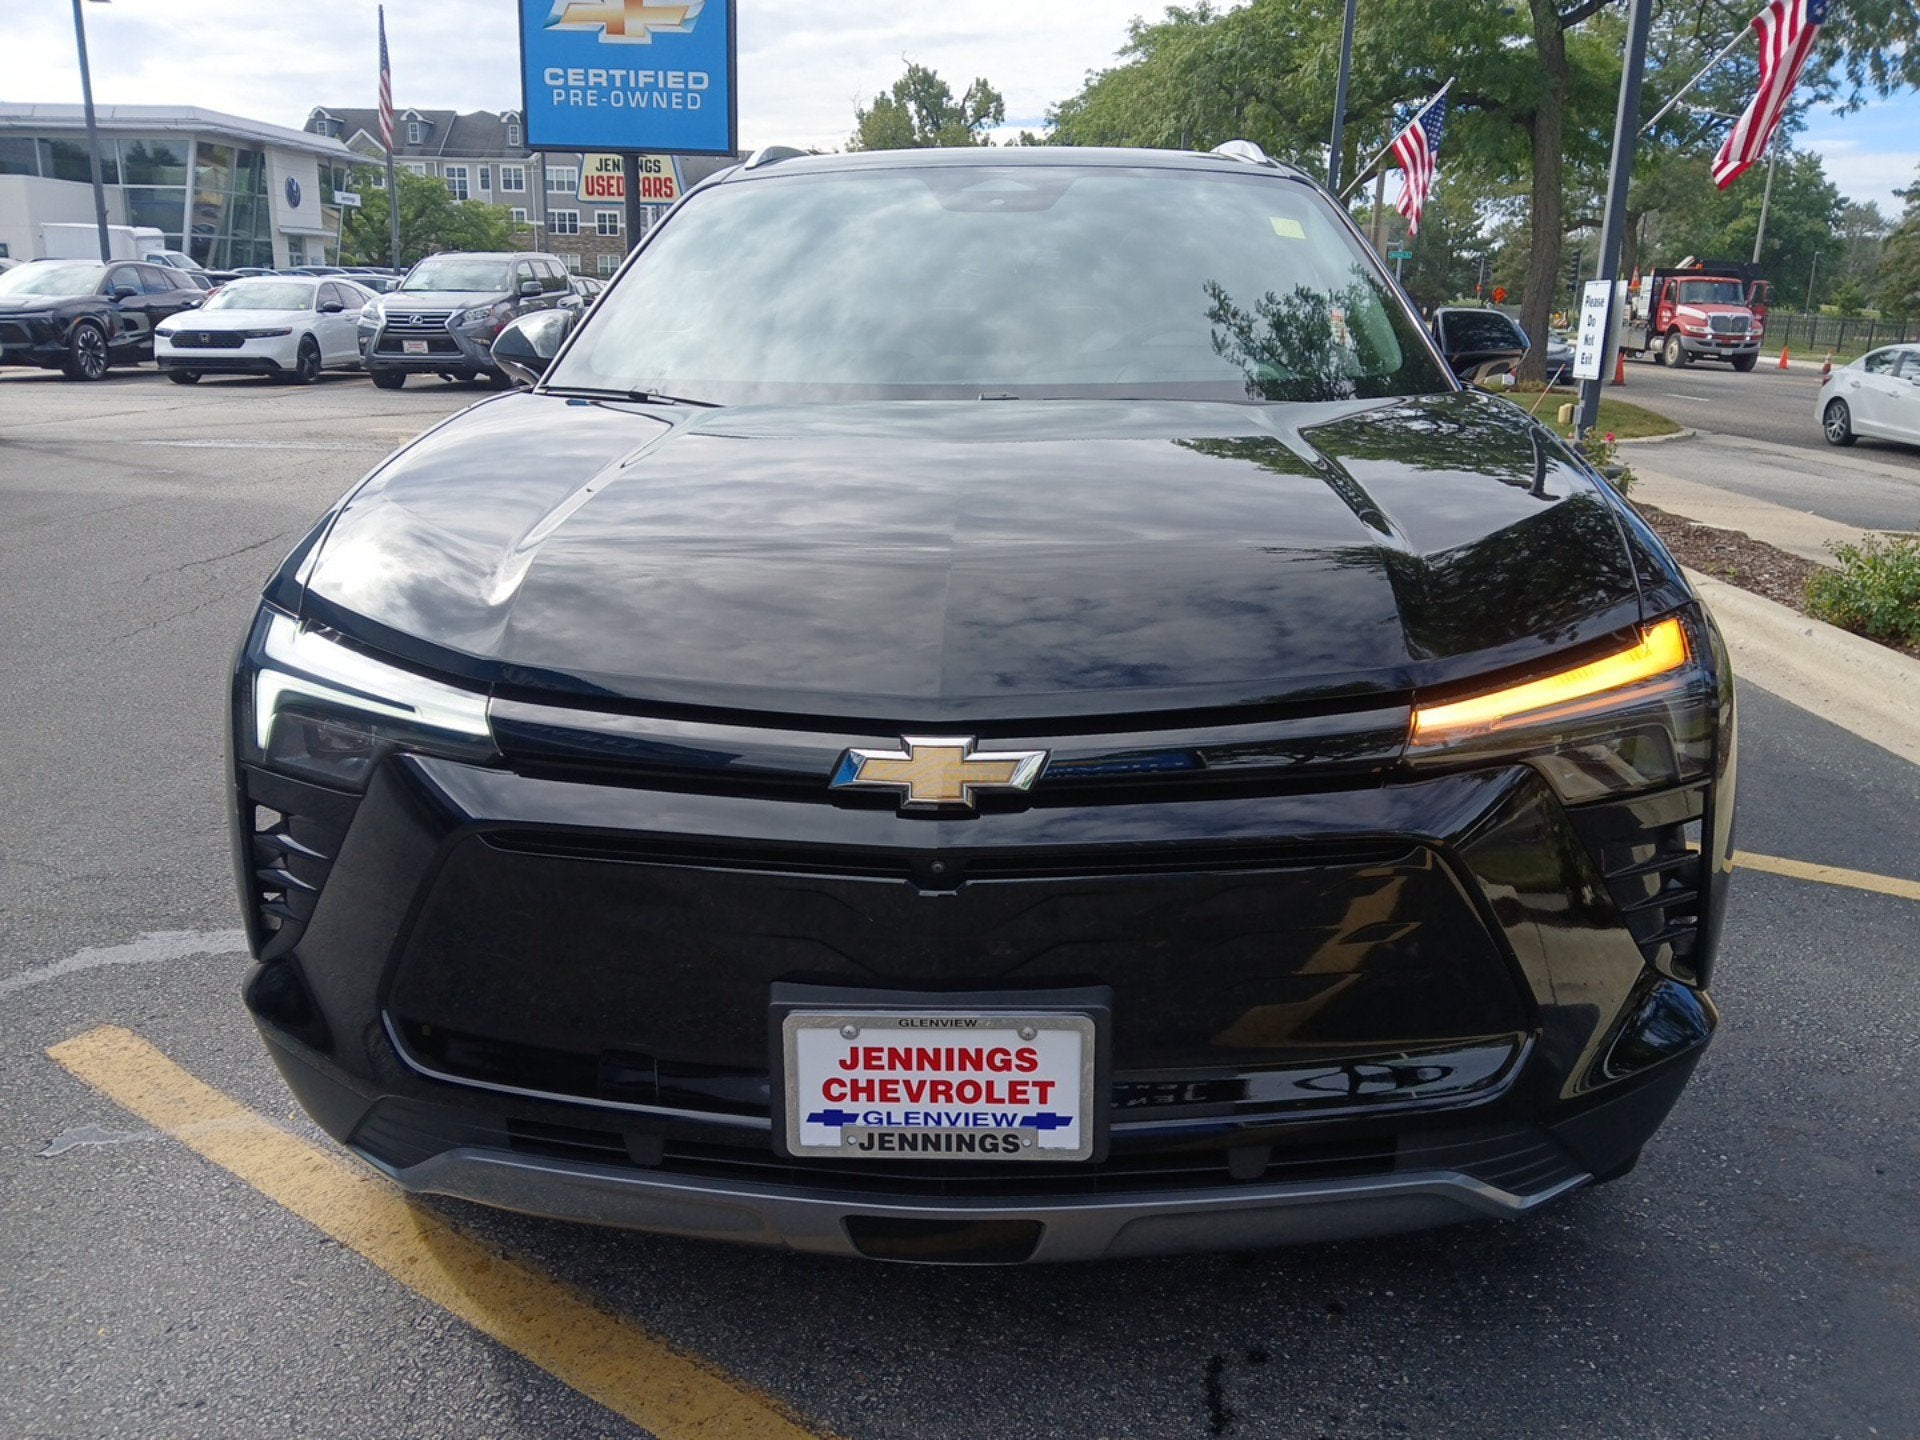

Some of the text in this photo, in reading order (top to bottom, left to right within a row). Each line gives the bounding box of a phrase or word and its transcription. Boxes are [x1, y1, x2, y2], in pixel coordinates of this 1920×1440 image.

[544, 67, 709, 90] CERTIFIED
[553, 89, 701, 110] PRE-OWNED
[596, 158, 661, 173] JENNGS
[585, 175, 674, 198] USED ARS
[1585, 295, 1604, 308] Please
[1587, 314, 1596, 327] Do
[1584, 333, 1595, 346] Not
[1580, 352, 1592, 365] Exit
[898, 1018, 977, 1028] GLENVIEW
[838, 1046, 1038, 1073] JENNINGS
[822, 1077, 1055, 1105] CHEVROLET
[862, 1110, 1019, 1128] GLENVIEW
[858, 1132, 1020, 1153] JENNINGS
